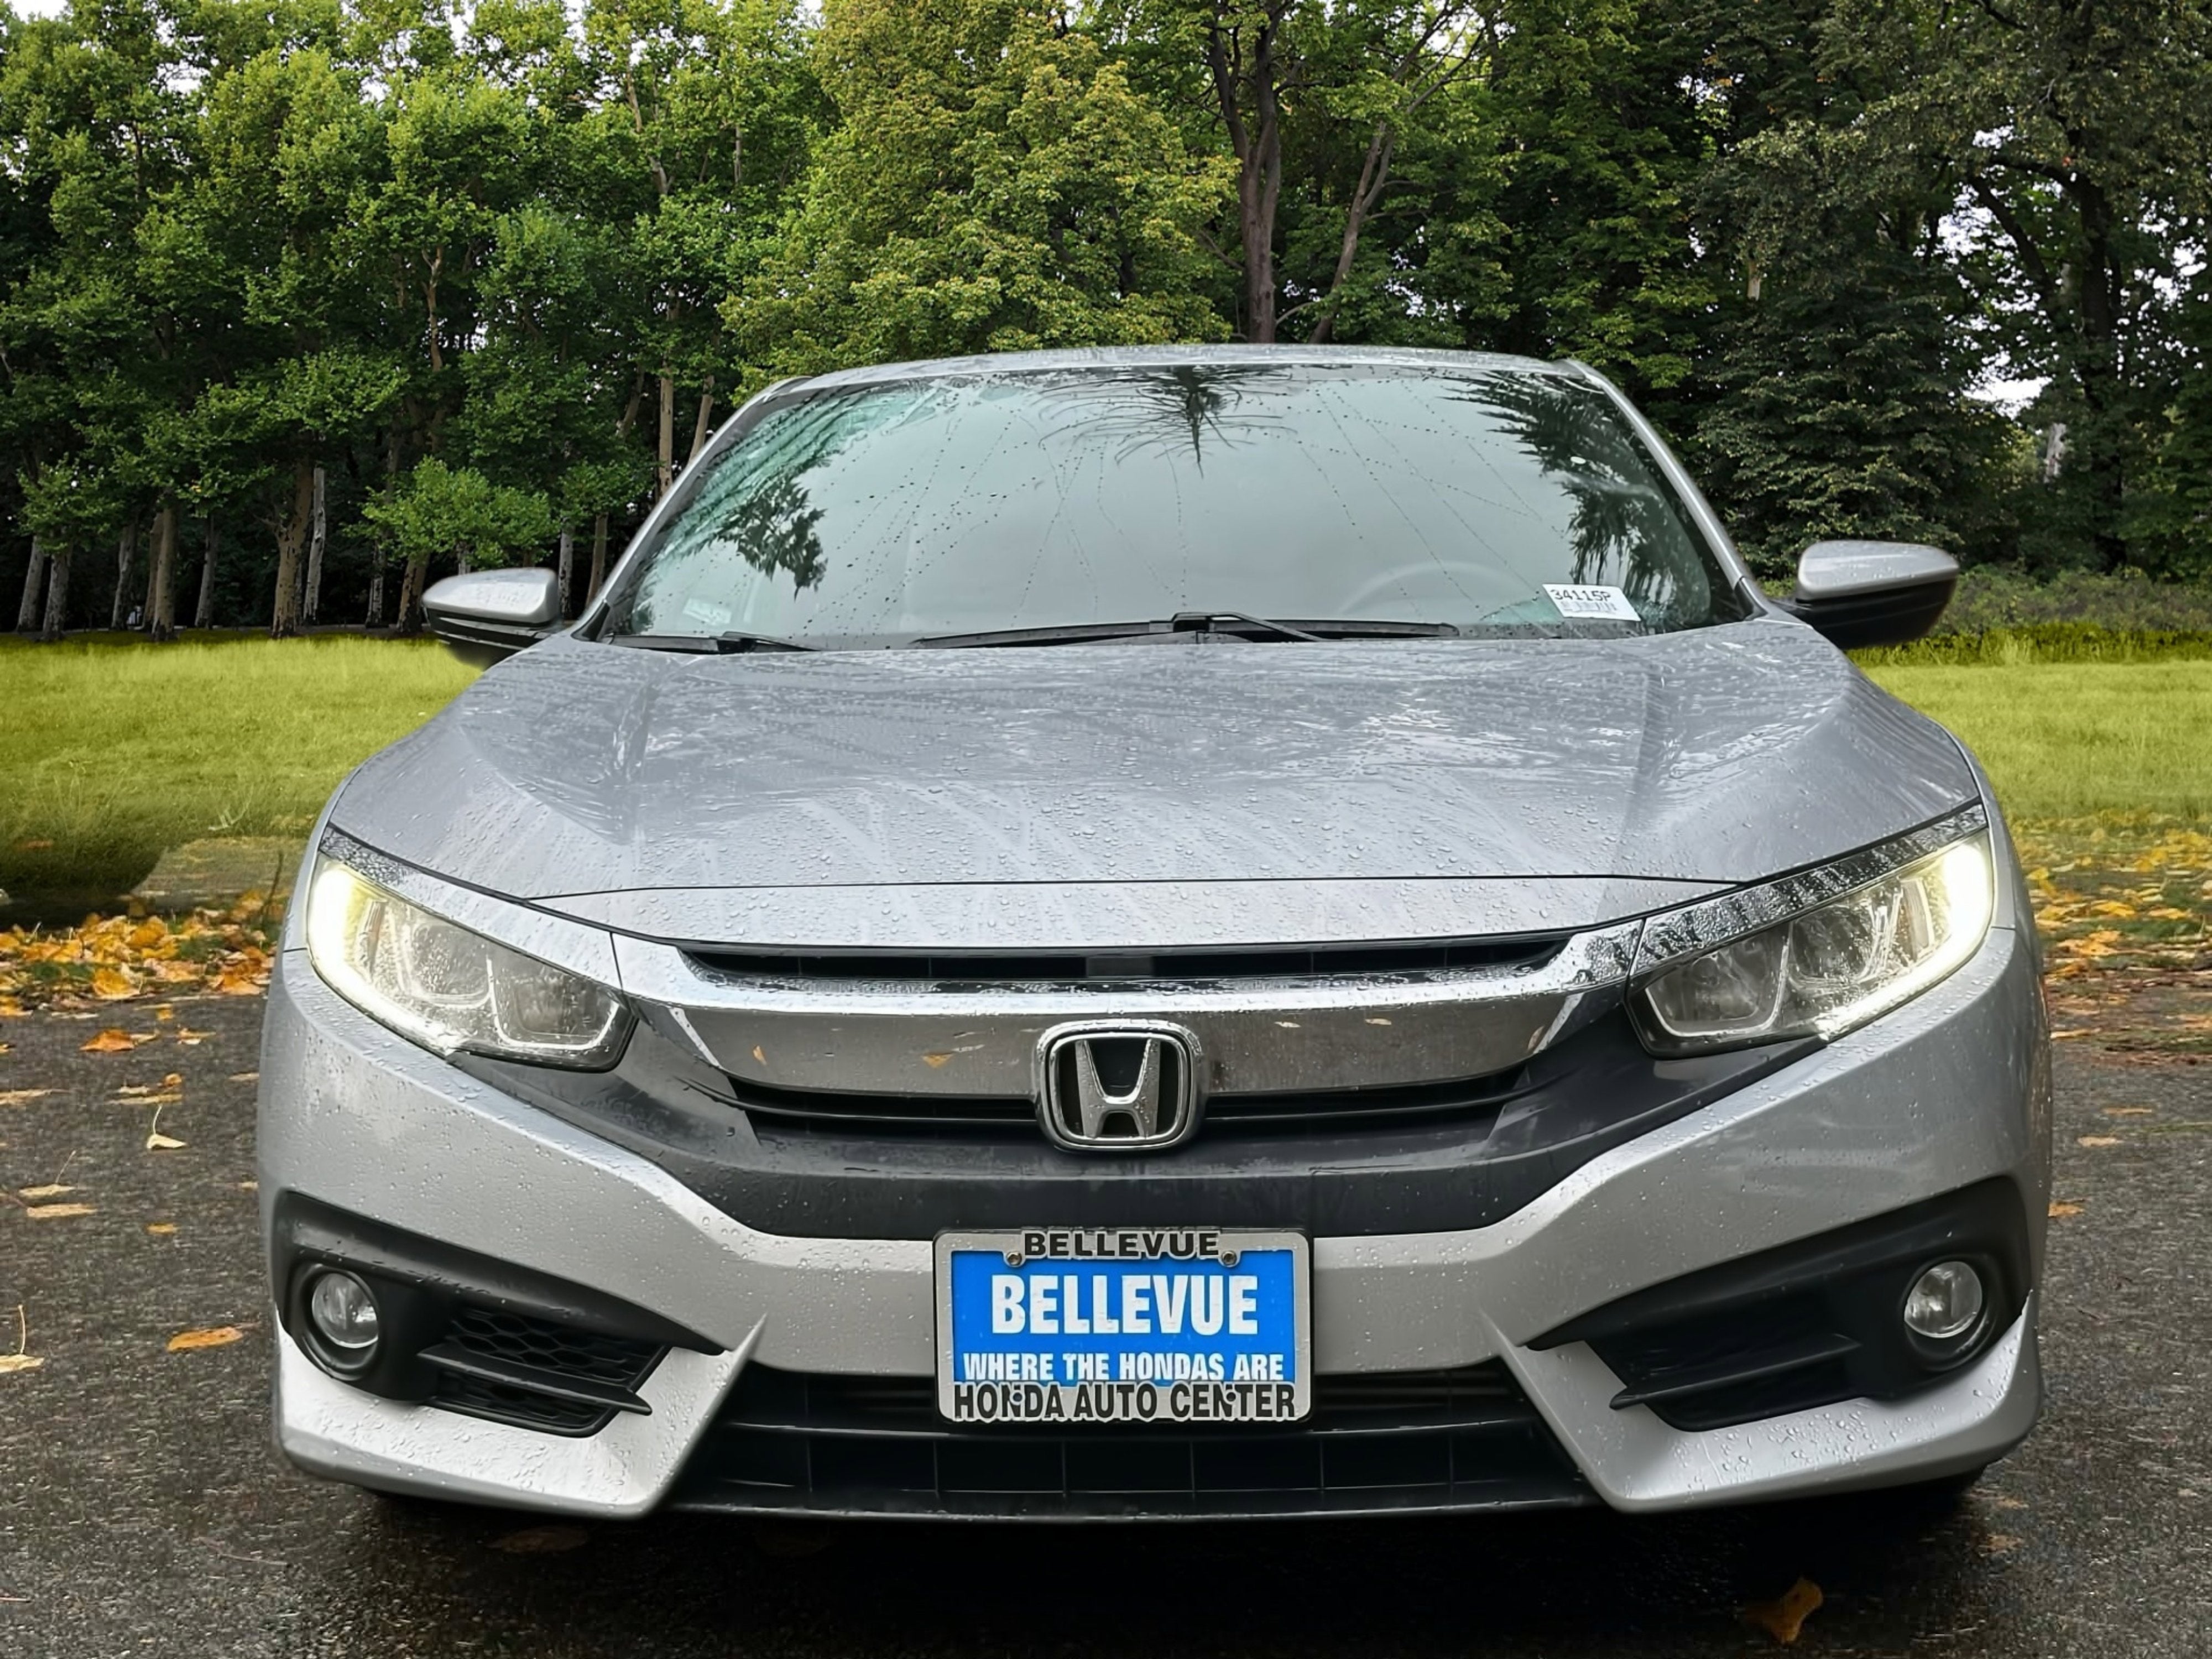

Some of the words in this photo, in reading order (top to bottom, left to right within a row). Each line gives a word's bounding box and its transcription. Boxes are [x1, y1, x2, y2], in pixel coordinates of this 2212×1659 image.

[1550, 589, 1611, 602] 34115P
[1024, 1233, 1219, 1257] BELLEVUE
[992, 1275, 1258, 1335] BELLEVUE
[963, 1353, 1054, 1381] WHERE
[1062, 1353, 1110, 1381] THE
[1119, 1352, 1225, 1381] HONDAS
[1233, 1353, 1284, 1381] ARE
[954, 1384, 1065, 1419] HONDA
[1073, 1383, 1158, 1419] AUTO
[1170, 1383, 1295, 1418] CENTER
